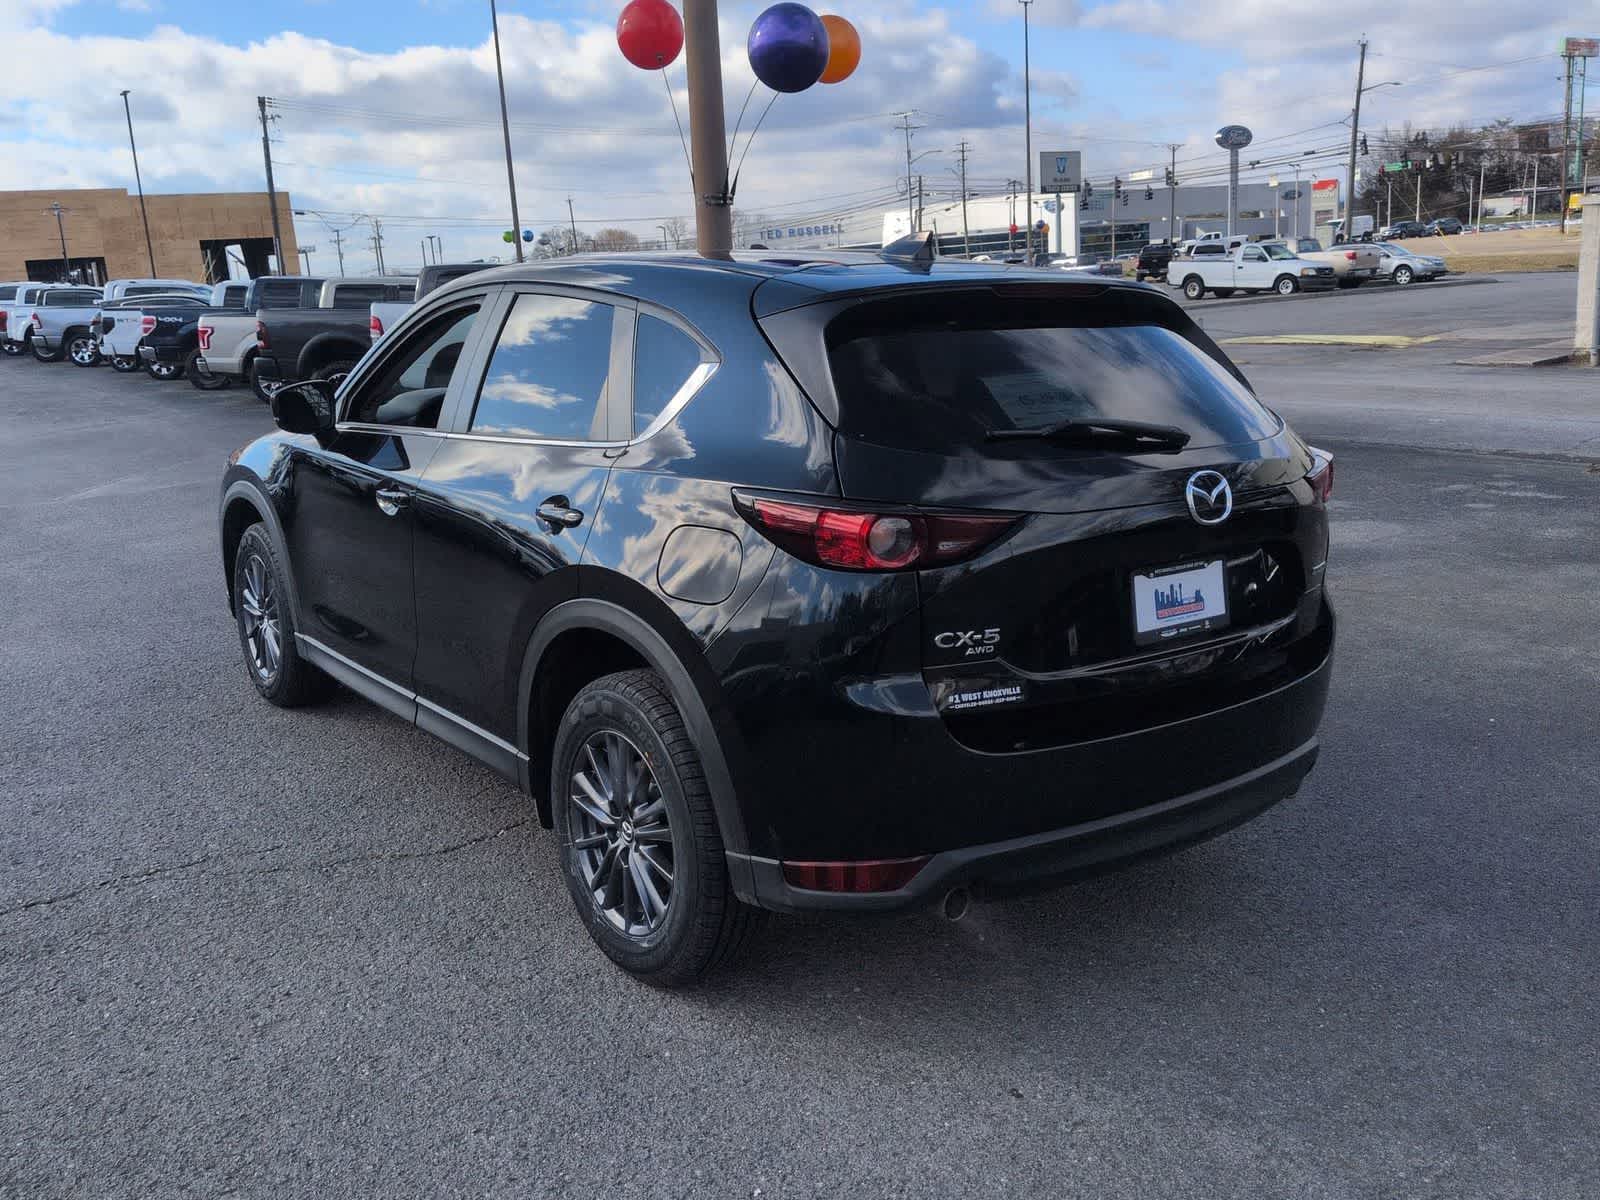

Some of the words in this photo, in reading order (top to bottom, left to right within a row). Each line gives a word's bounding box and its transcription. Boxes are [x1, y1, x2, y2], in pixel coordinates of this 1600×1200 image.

[788, 223, 844, 238] RUSSELL
[934, 627, 1001, 648] CX-5
[965, 645, 995, 656] AWD
[961, 692, 982, 701] WEST
[983, 686, 1021, 698] KNOXVILLE
